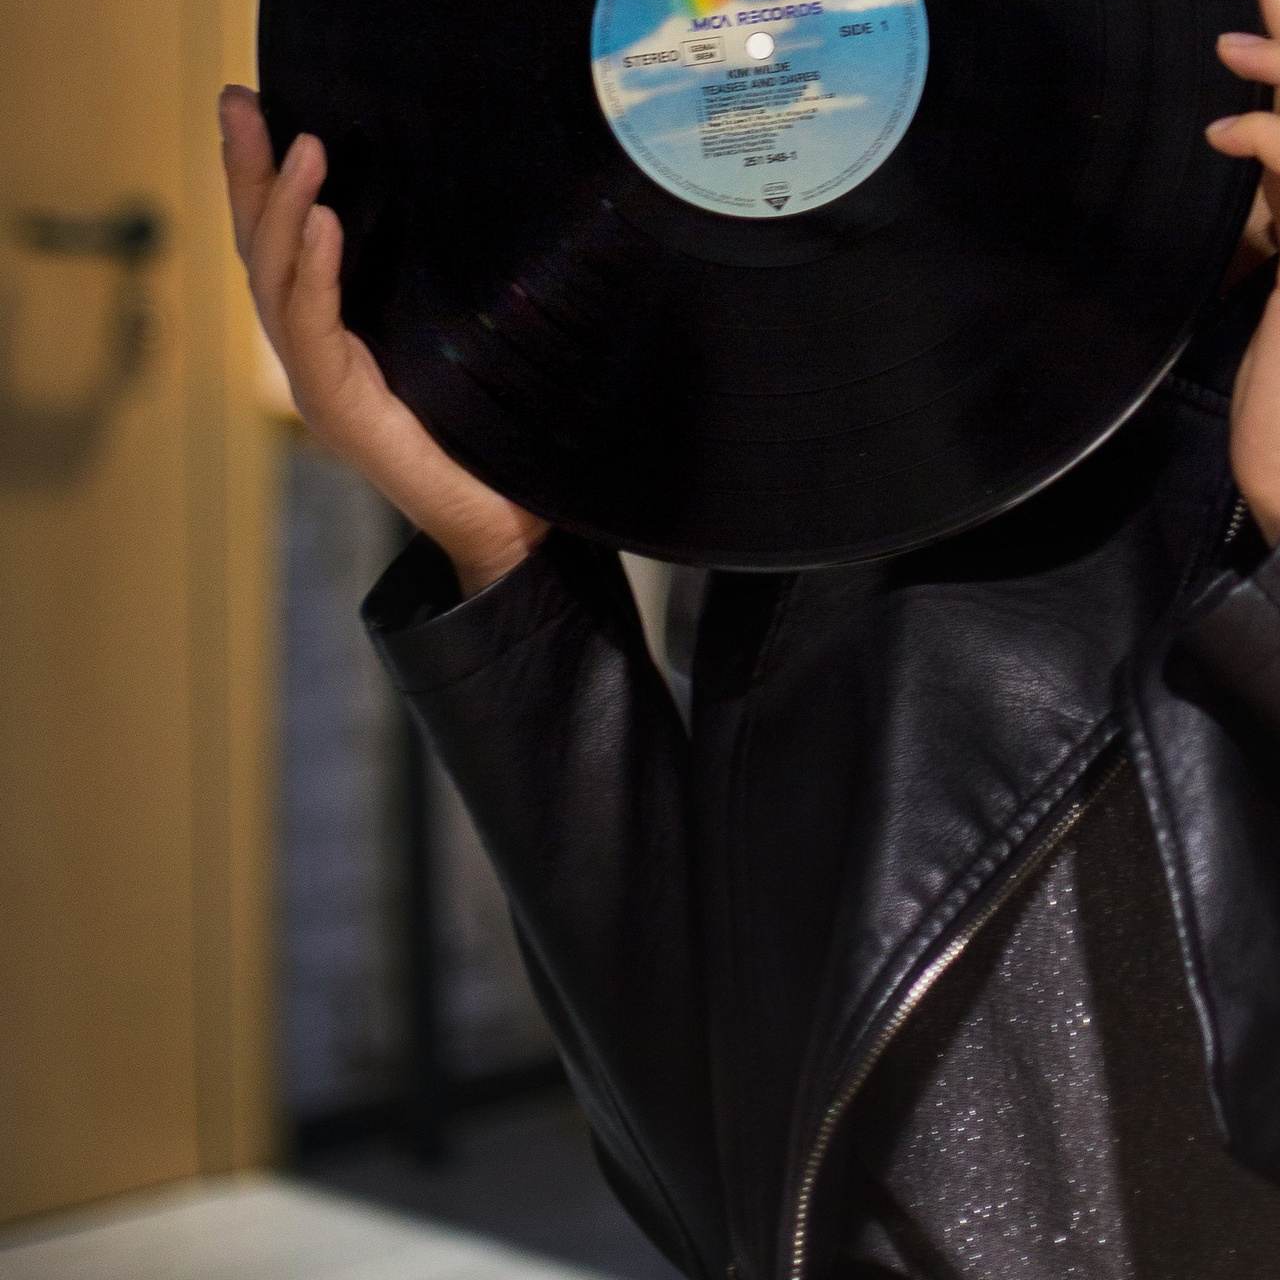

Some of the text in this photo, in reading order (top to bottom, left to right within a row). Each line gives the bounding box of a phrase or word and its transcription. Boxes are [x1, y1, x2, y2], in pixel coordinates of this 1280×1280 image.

[688, 1, 824, 33] MCA RECORDS
[839, 20, 889, 38] SIDE 1
[623, 49, 680, 68] STEREO
[754, 61, 791, 75] WILDE
[780, 70, 820, 86] DARES
